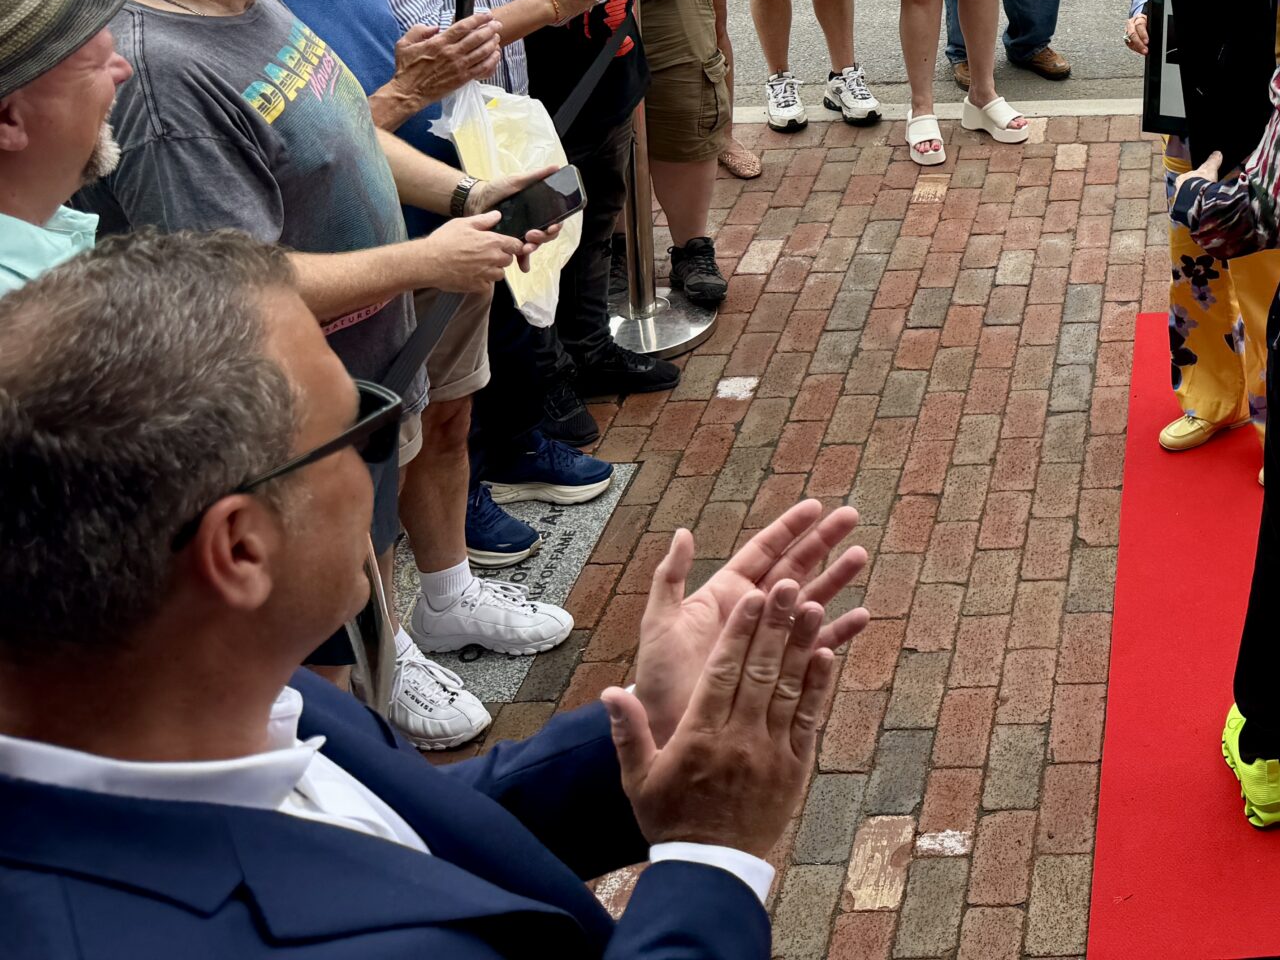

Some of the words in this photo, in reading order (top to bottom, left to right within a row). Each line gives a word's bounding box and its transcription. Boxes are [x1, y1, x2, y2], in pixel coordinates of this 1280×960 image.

[540, 563, 557, 579] OF
[549, 530, 577, 560] FAME
[404, 689, 434, 713] K-SWISS
